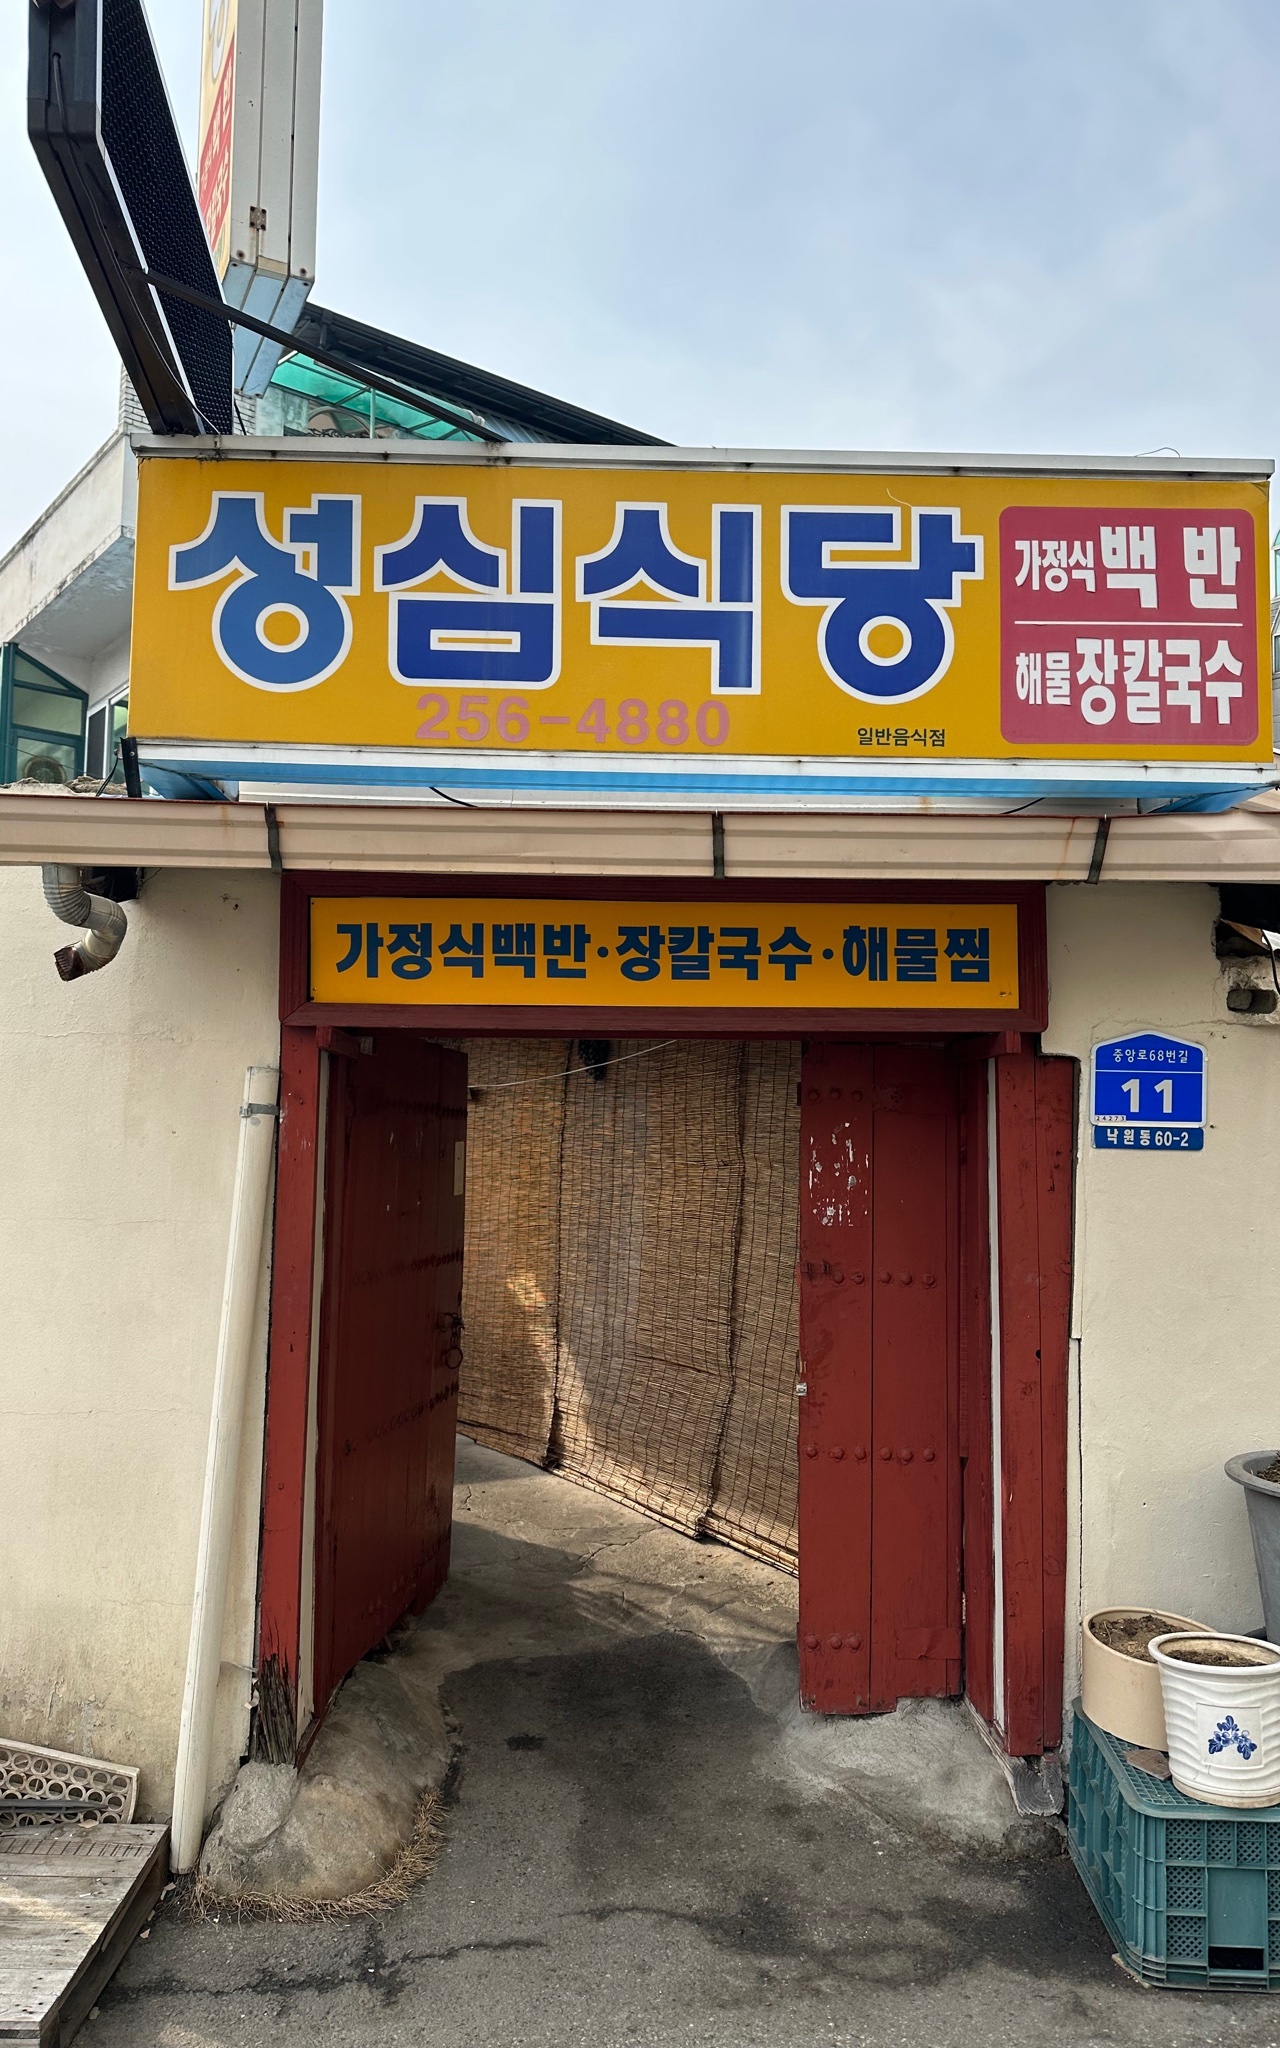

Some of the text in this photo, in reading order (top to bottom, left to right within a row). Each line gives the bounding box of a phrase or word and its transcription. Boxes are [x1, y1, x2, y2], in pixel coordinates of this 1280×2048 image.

[1014, 540, 1096, 593] 가정식
[168, 491, 985, 705] 성심식당
[1015, 638, 1243, 725] 해물 장칼국수
[416, 693, 730, 747] 256-4880
[856, 727, 946, 748] 일반음식점
[1113, 1048, 1189, 1064] 중앙로68번길
[1121, 1078, 1173, 1114] 11
[1106, 1128, 1189, 1147] 낙원동 60-2
